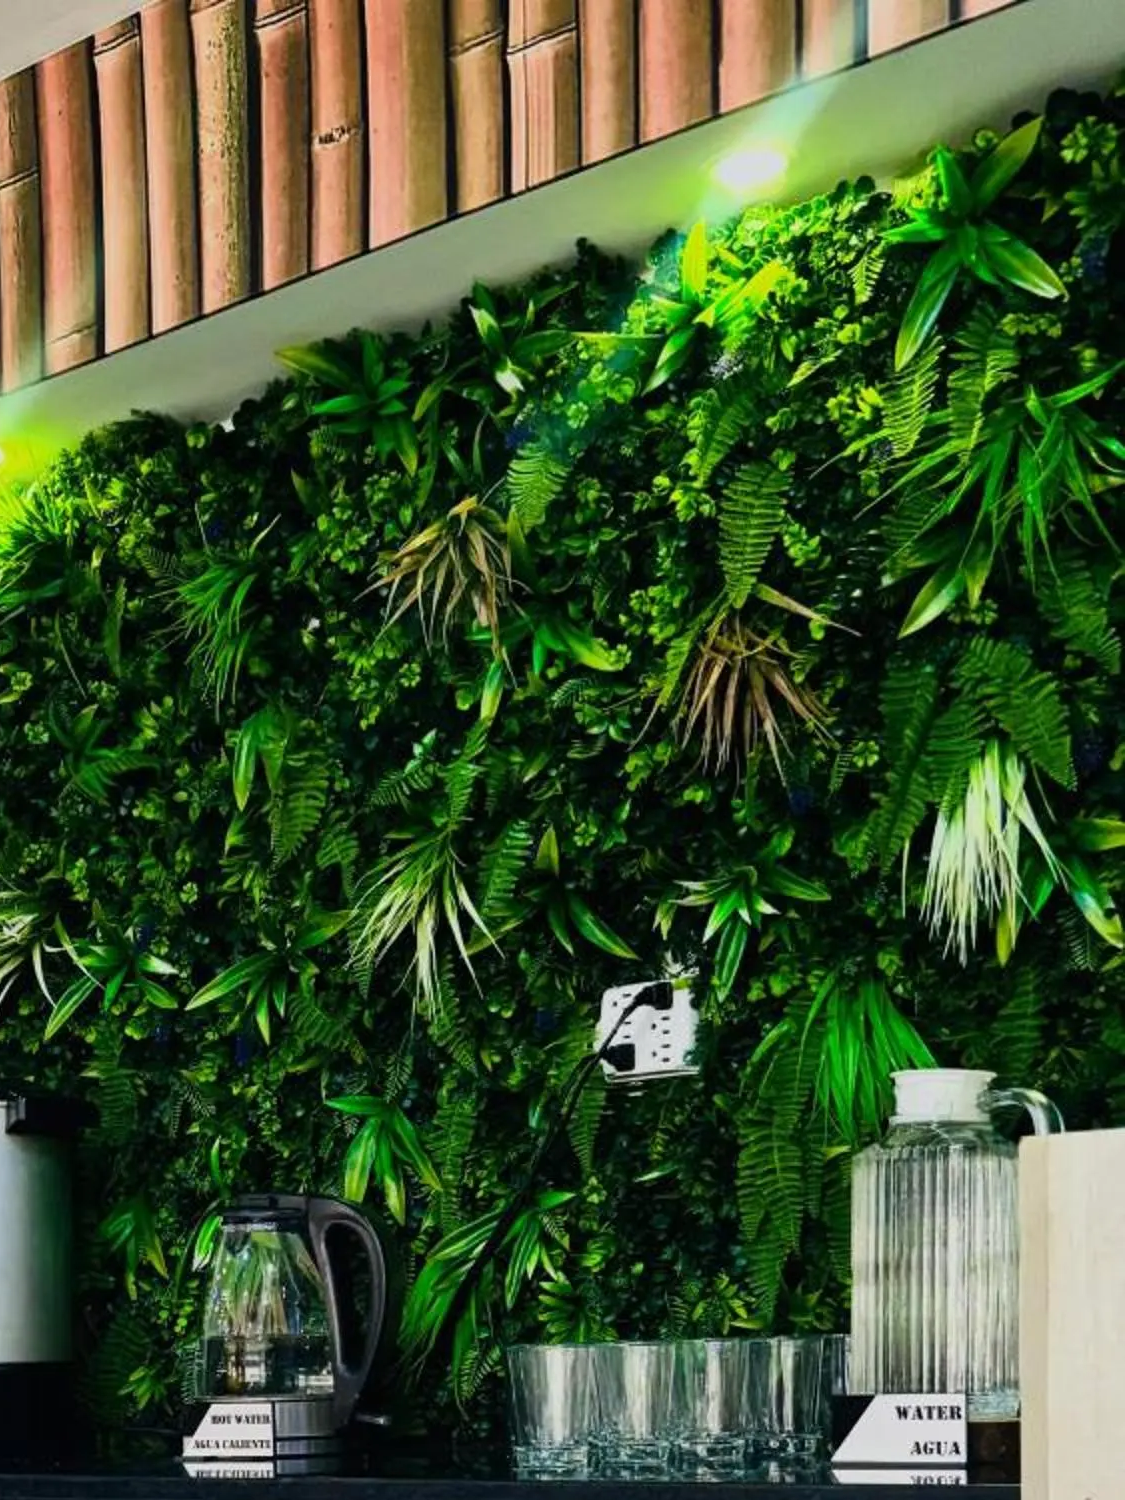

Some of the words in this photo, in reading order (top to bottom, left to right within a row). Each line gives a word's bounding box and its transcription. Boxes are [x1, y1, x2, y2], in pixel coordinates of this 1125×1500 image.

[211, 1414, 231, 1425] HOT
[234, 1414, 271, 1425] WATER
[895, 1405, 962, 1421] WATER
[192, 1439, 221, 1449] AGUA
[222, 1439, 271, 1449] CALIENTE
[910, 1441, 961, 1456] AGUA
